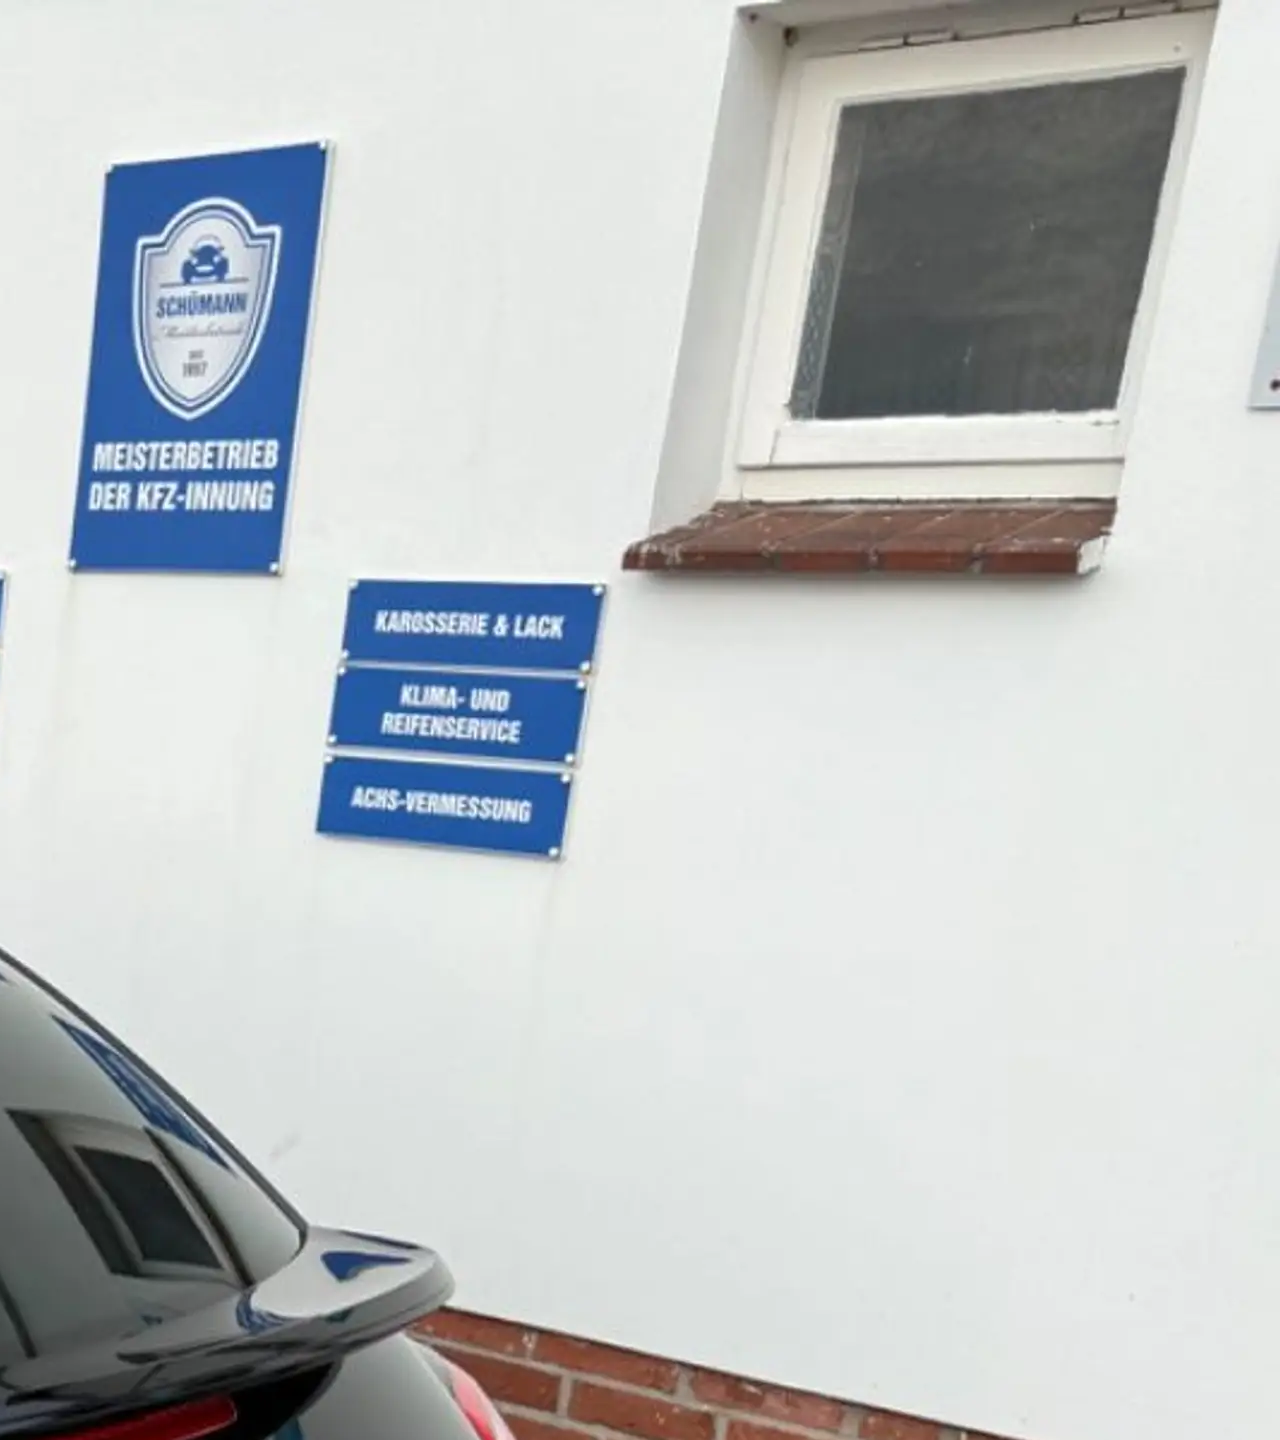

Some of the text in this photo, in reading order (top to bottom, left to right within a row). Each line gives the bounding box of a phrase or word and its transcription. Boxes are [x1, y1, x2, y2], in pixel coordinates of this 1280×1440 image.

[156, 290, 248, 319] SCHÜMANN
[92, 439, 280, 472] MEISTERBETRIEB
[88, 481, 275, 512] DER KFZ-INNUNG
[374, 610, 565, 640] KAROSSERIE & LACK
[399, 684, 512, 713] KLIMA- UND
[380, 712, 523, 744] REIFENSERVICE
[351, 786, 533, 824] ACHS-VERMESSUNG
